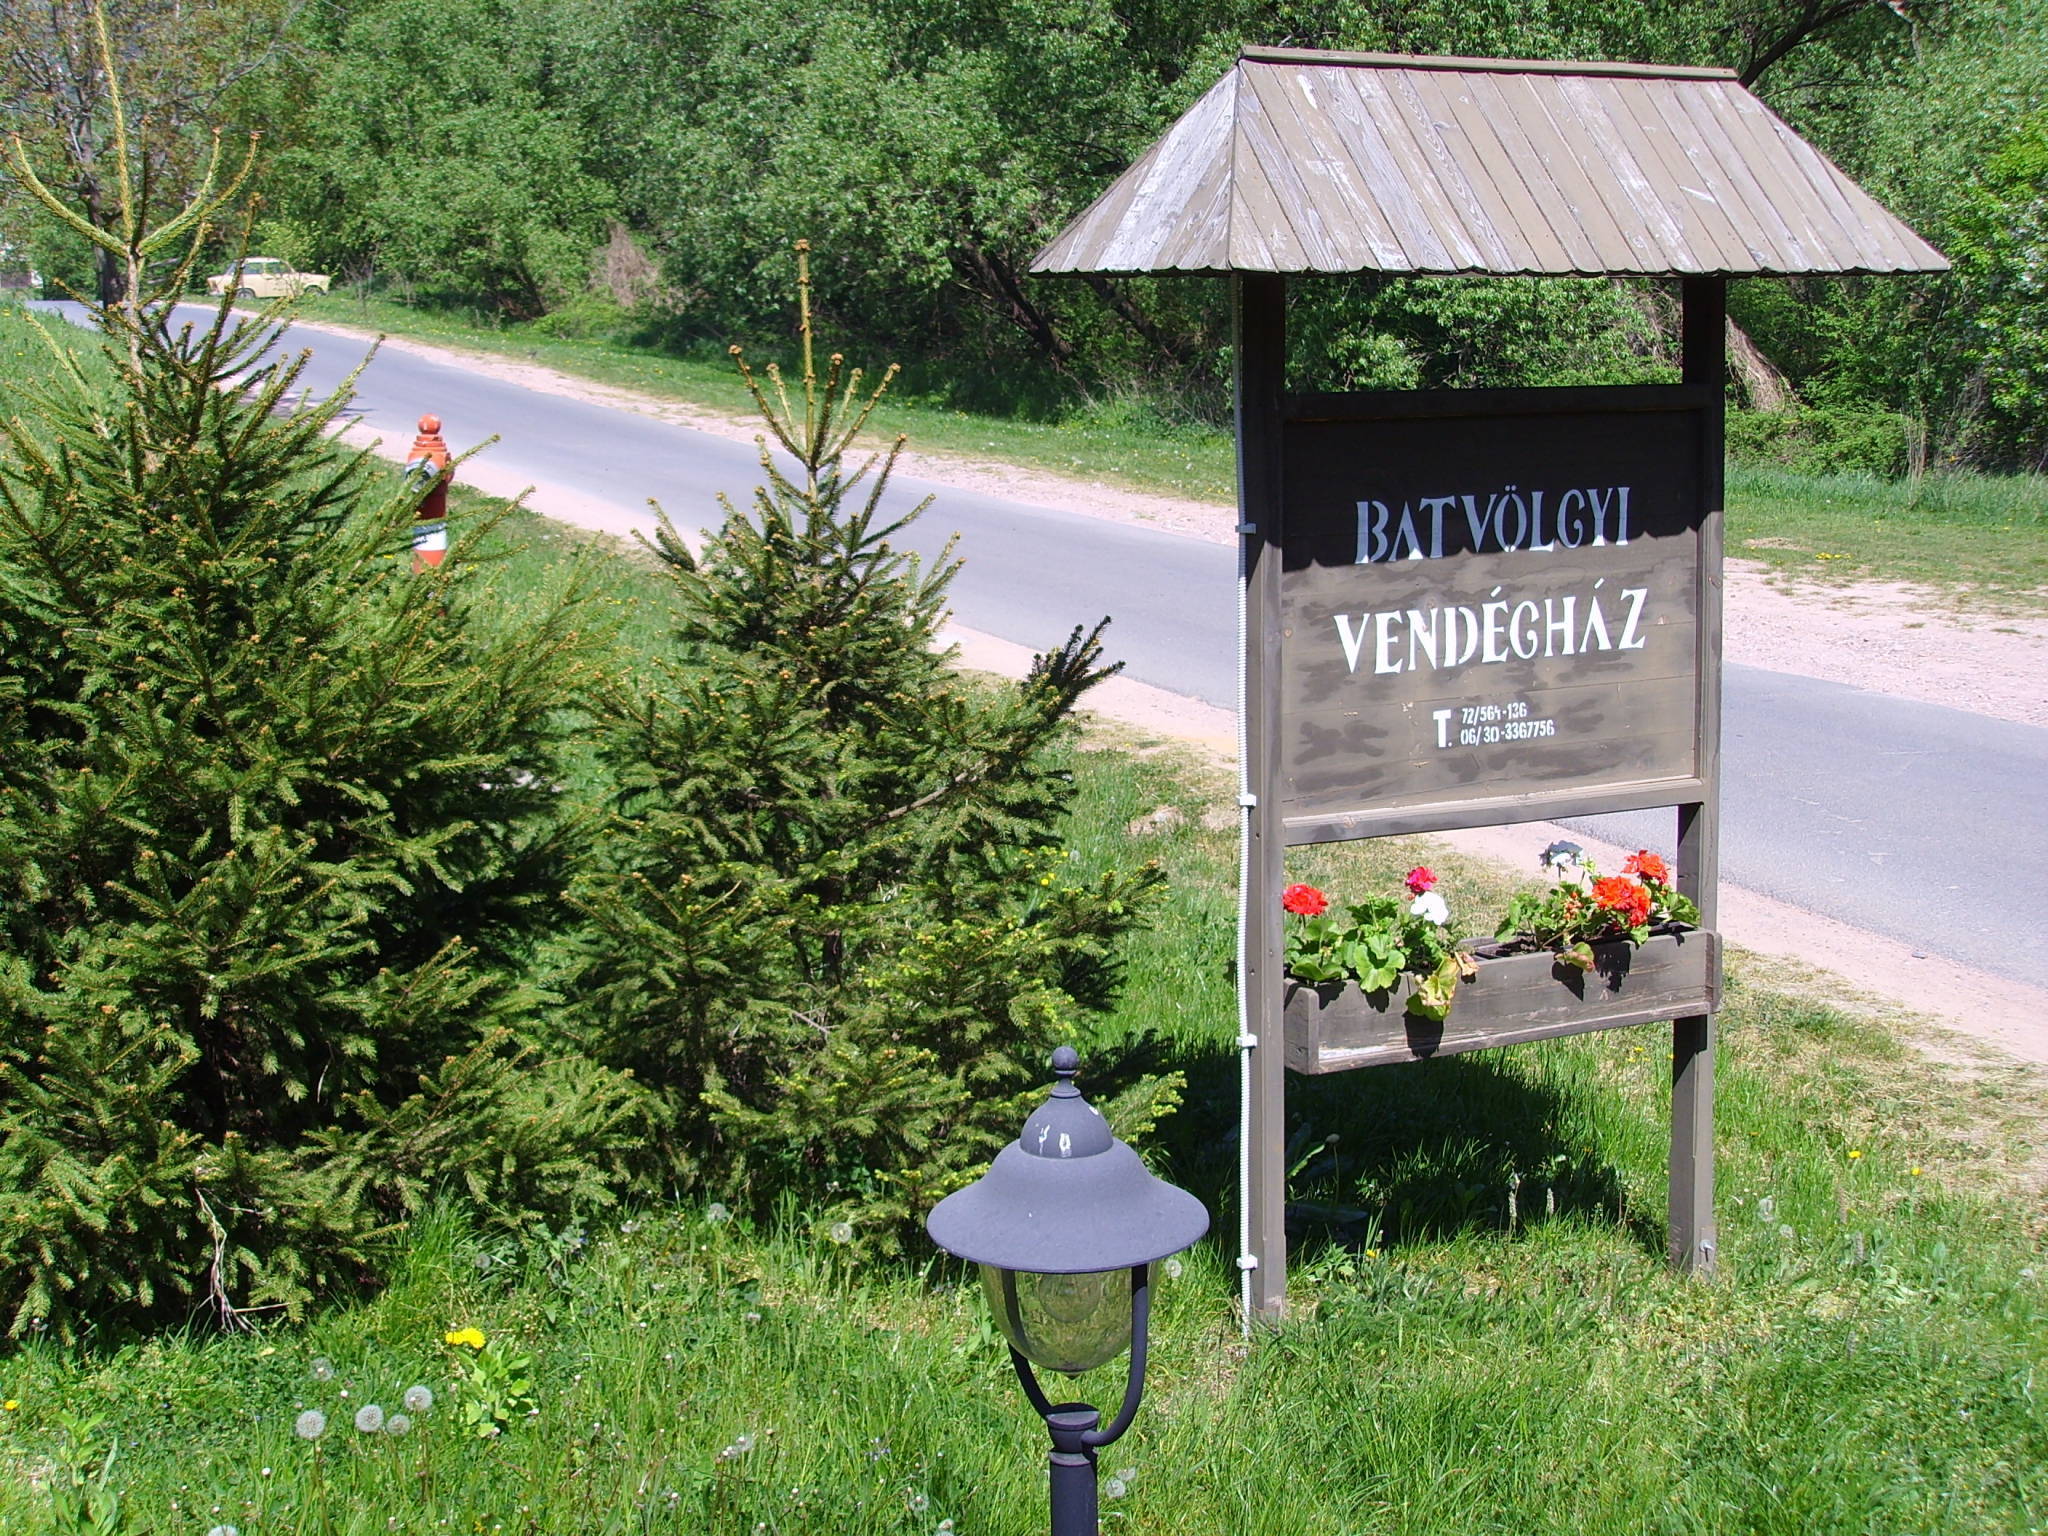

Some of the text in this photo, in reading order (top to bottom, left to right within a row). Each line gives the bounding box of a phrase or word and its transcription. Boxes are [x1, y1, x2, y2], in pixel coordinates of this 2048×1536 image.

[1355, 486, 1630, 564] BATVÖLGYI
[1334, 578, 1648, 675] VENDÉGHÁZ
[1433, 709, 1453, 748] T.
